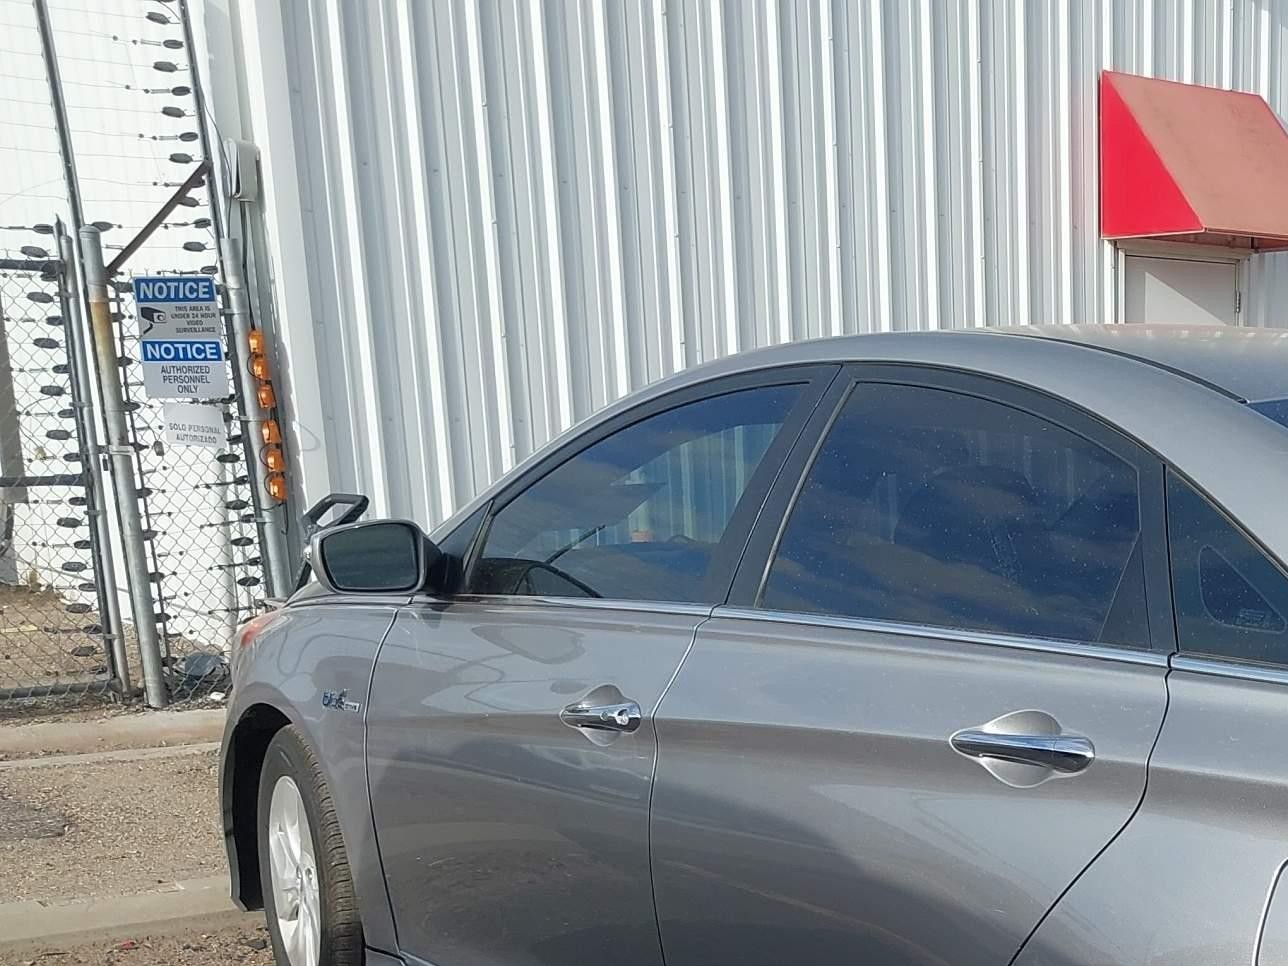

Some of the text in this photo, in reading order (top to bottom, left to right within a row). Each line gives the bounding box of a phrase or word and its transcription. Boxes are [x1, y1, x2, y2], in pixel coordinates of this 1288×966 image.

[139, 281, 211, 299] NOTICE
[146, 343, 219, 360] NOTICE
[160, 365, 211, 375] AUTHORIZED
[162, 375, 211, 384] PERSONNEL
[177, 384, 198, 394] ONLY
[169, 422, 221, 434] SOLO PERSONAL
